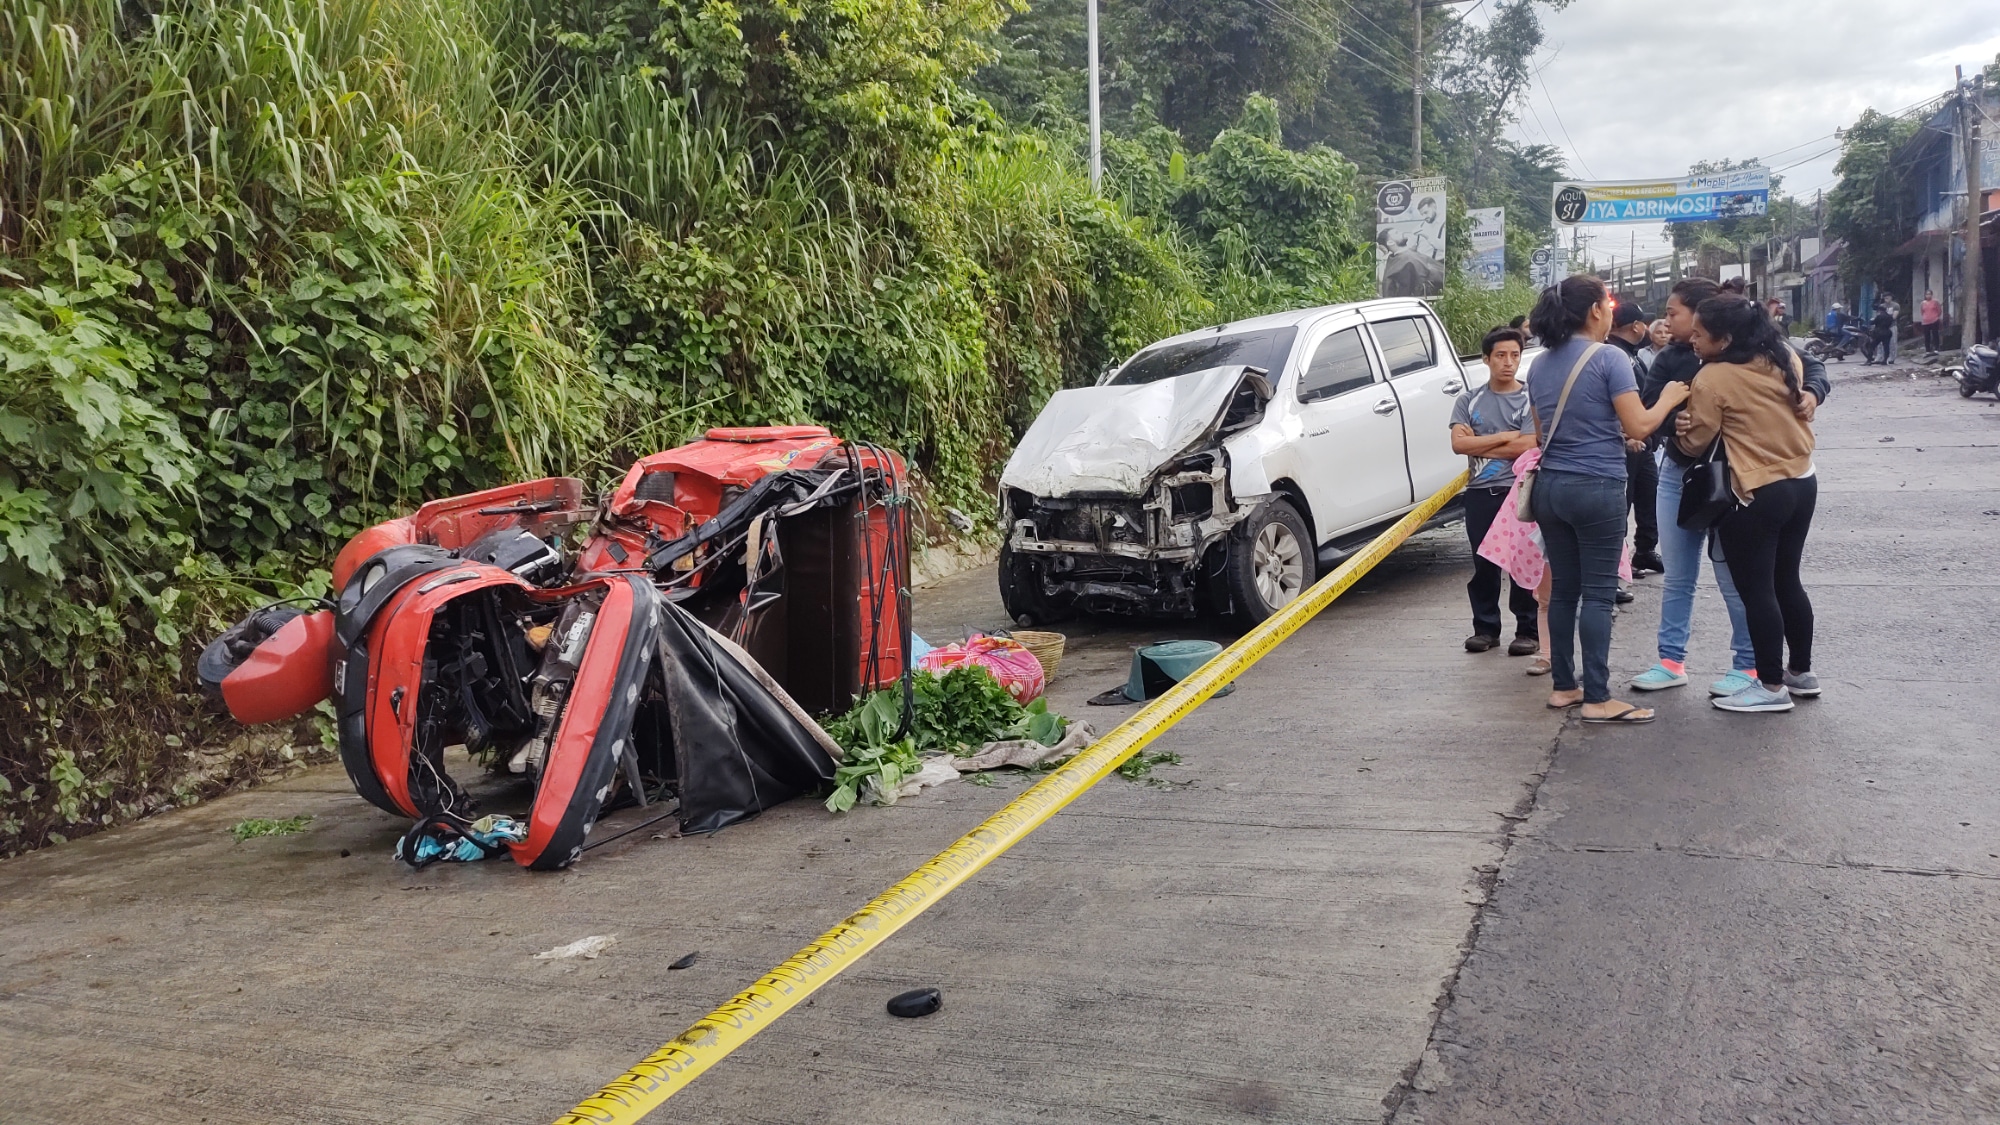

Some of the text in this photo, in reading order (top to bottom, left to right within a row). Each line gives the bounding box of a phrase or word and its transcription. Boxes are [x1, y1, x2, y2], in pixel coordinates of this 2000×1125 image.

[1697, 177, 1726, 189] Maple
[1561, 203, 1580, 220] SI
[1591, 201, 1618, 219] ¡YA
[701, 992, 775, 1030] PASO
[586, 1047, 697, 1108] ESCENA
